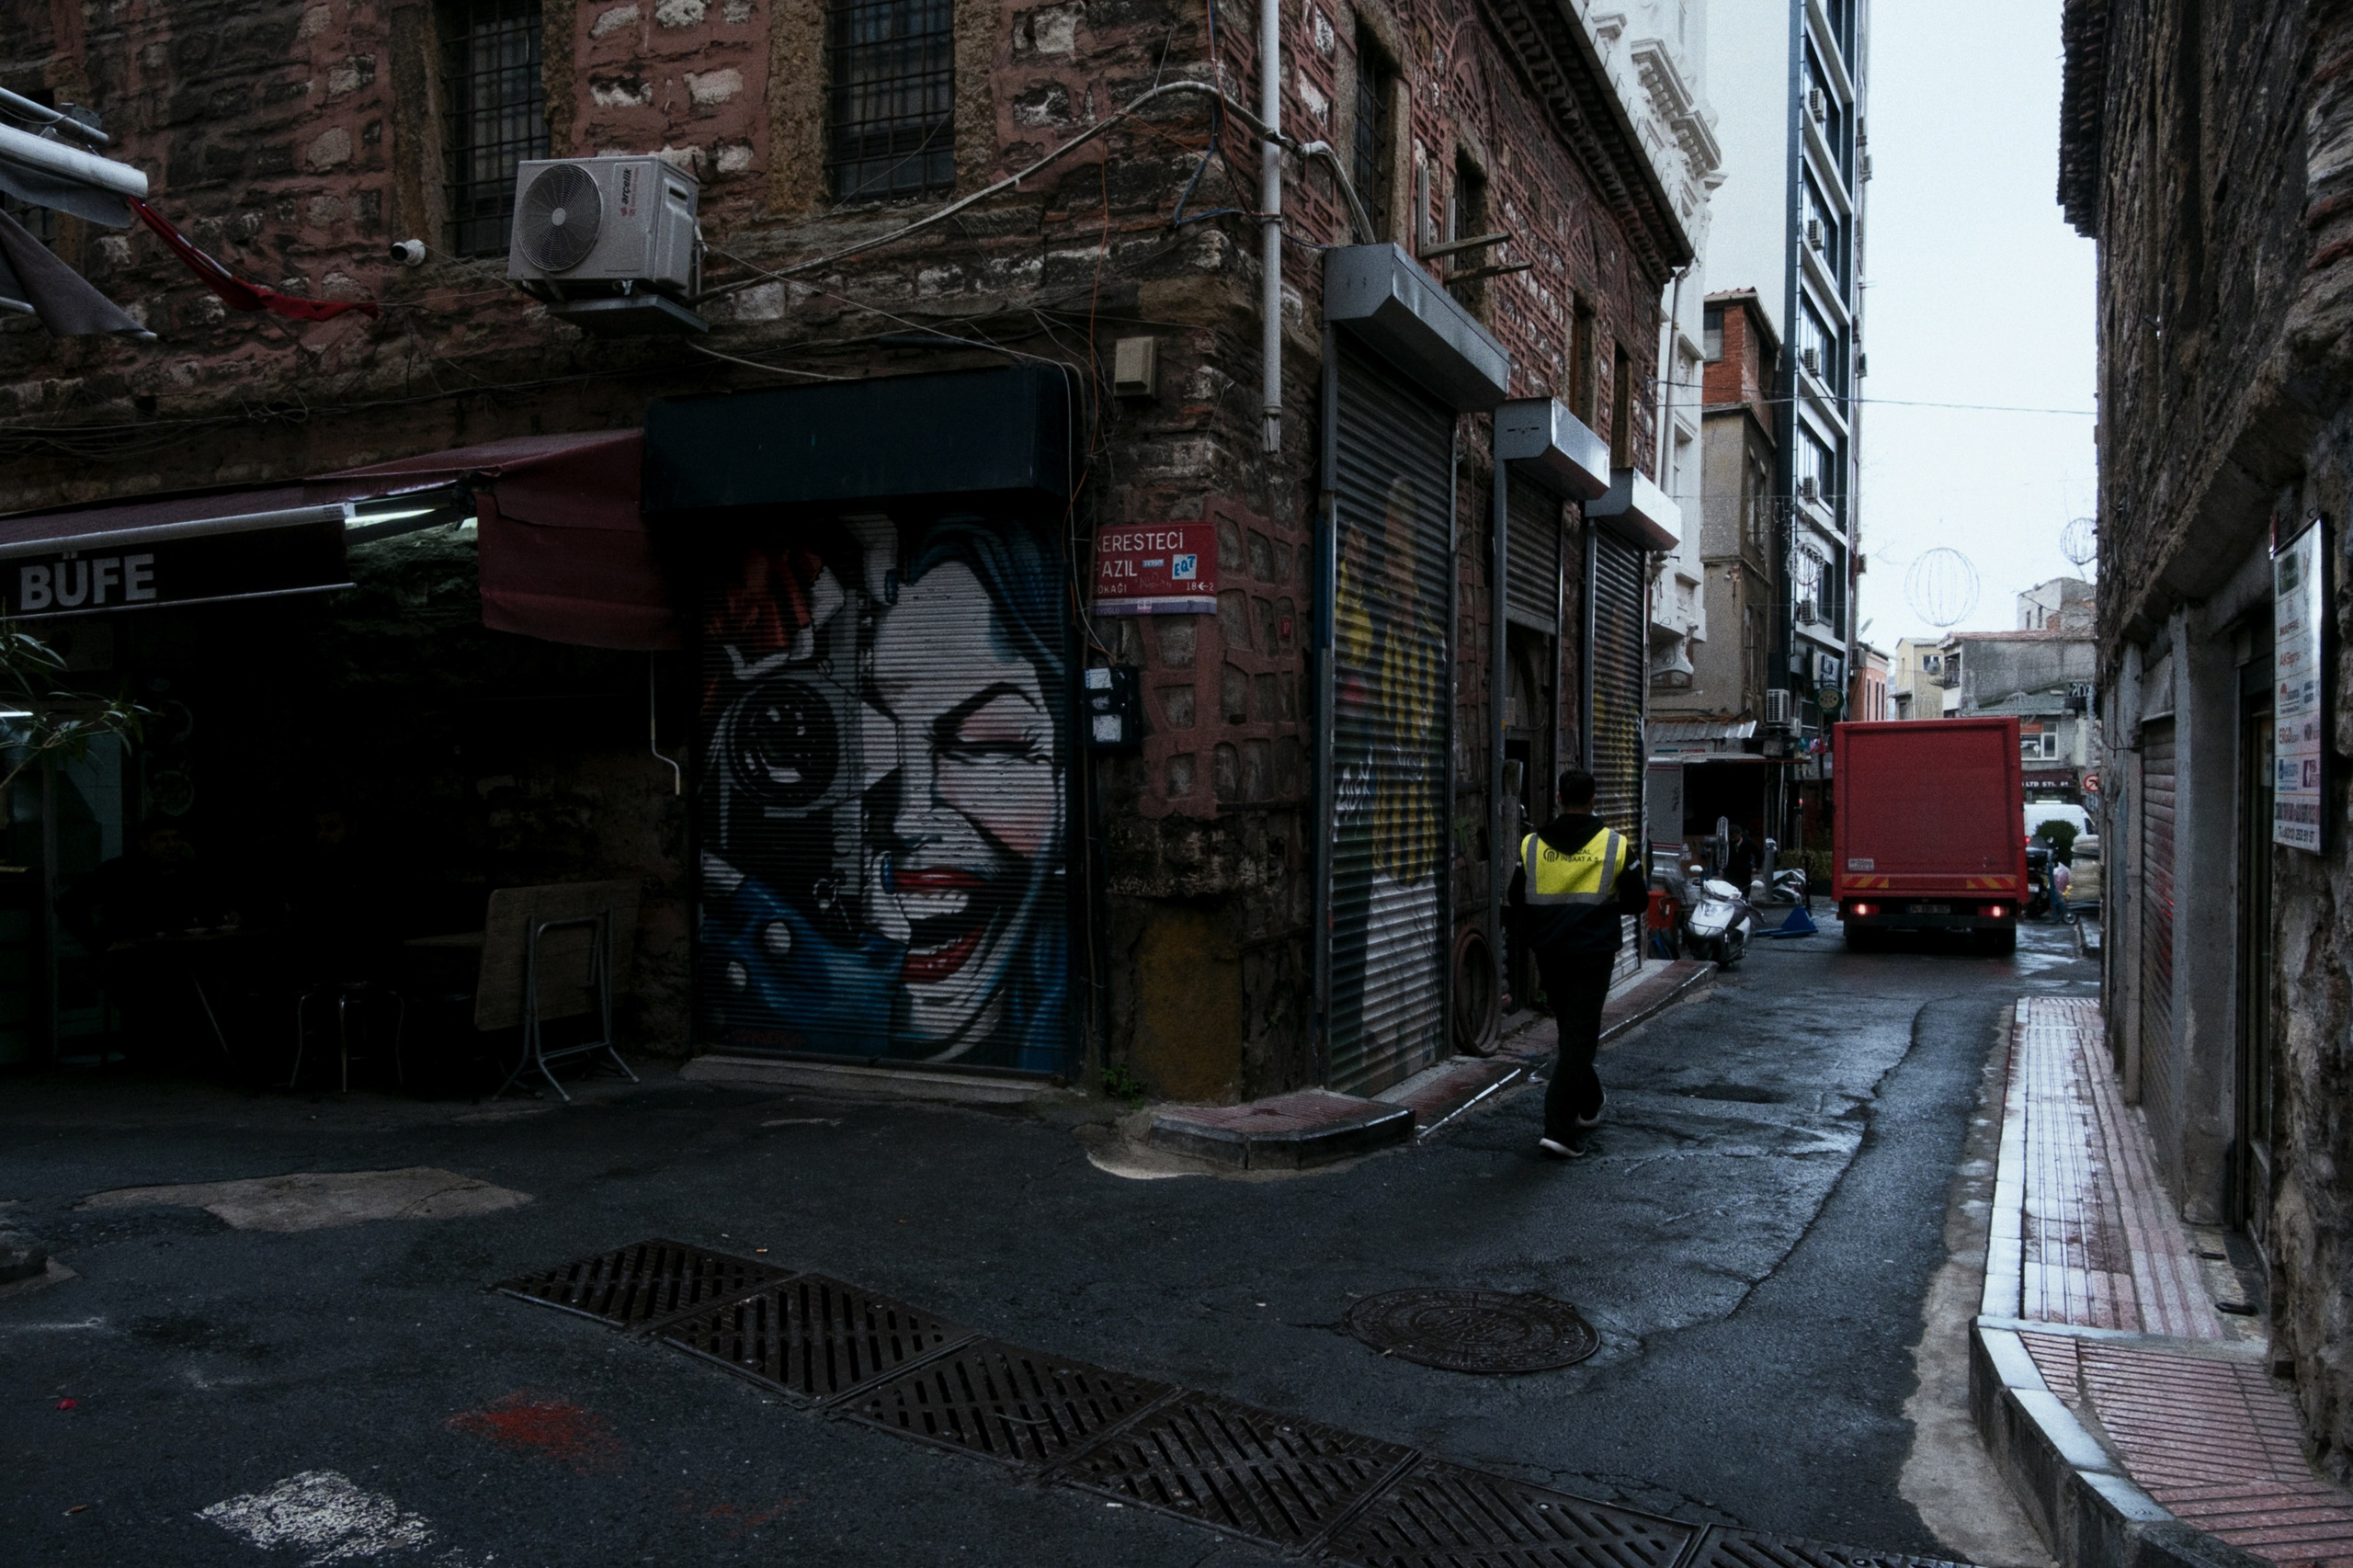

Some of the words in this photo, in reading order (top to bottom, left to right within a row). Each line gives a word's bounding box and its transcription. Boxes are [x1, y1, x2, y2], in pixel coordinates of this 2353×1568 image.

[621, 168, 631, 205] arçelik
[20, 551, 157, 611] BÜFE
[1187, 582, 1196, 591] 18
[1209, 583, 1214, 591] 2
